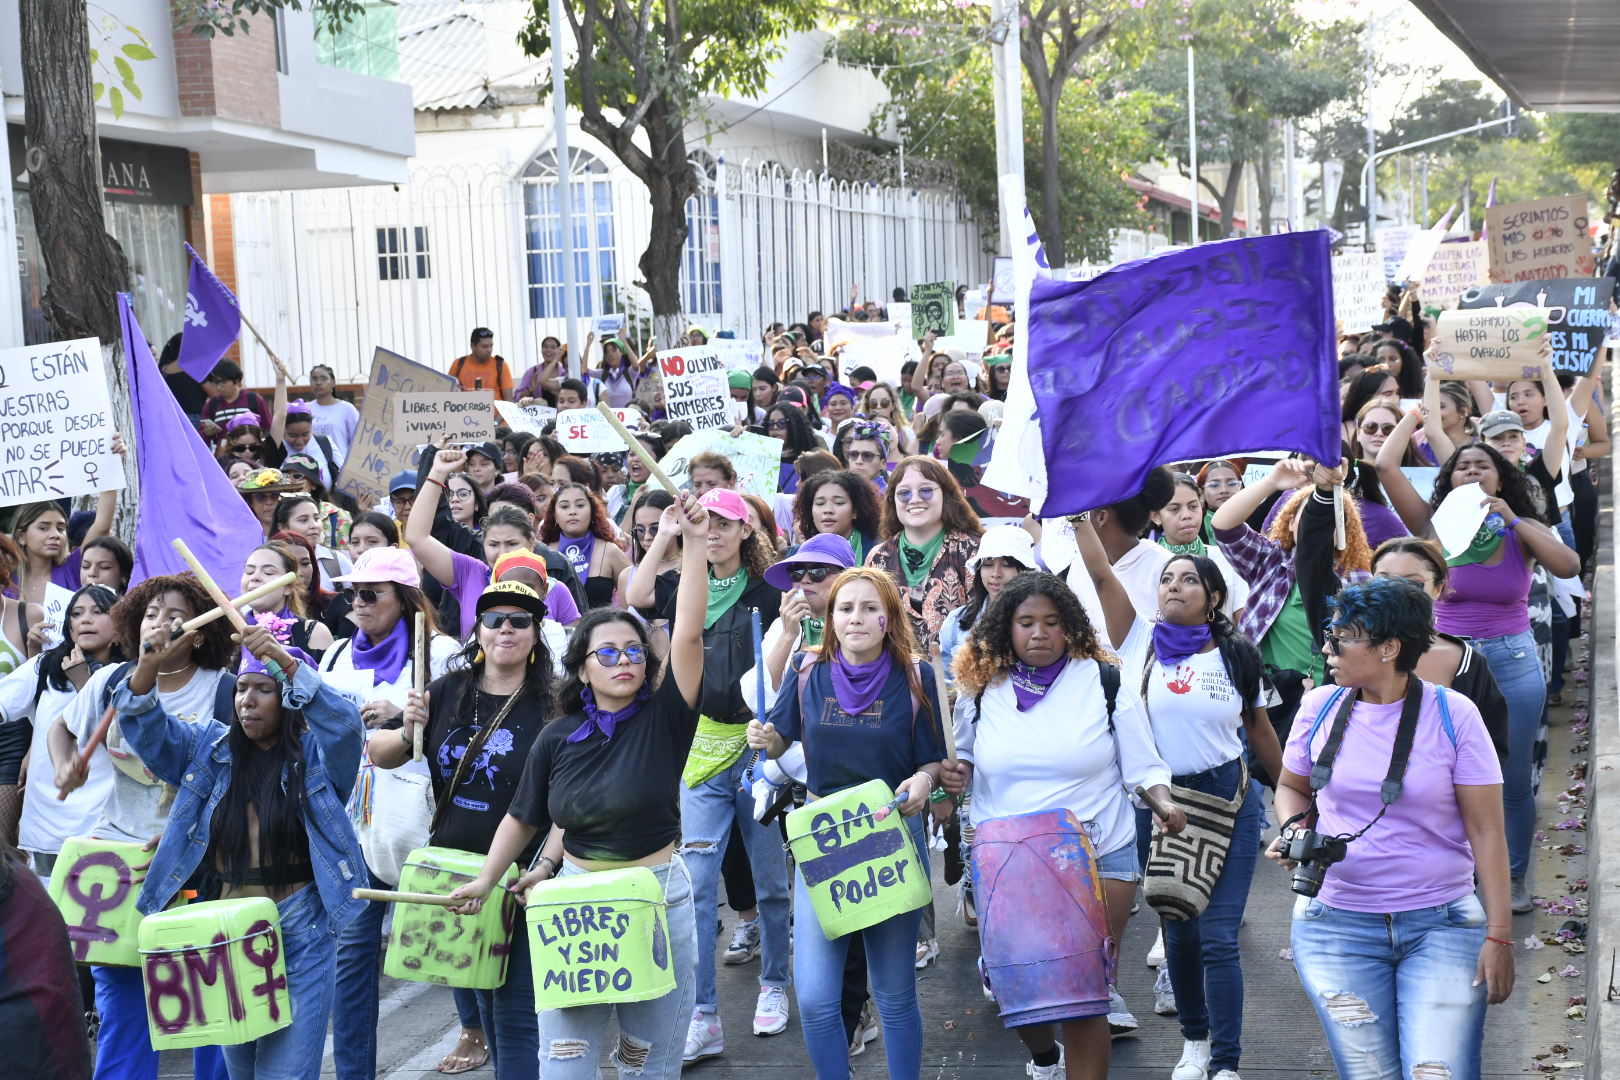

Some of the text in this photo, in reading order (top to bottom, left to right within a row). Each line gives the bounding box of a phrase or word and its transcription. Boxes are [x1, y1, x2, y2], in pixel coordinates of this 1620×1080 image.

[107, 161, 151, 189] ANA
[1574, 286, 1596, 306] MI
[1455, 328, 1520, 343] HASTA LOS
[1551, 331, 1589, 351] ES MI
[30, 344, 89, 381] ESTÁN
[1470, 346, 1512, 359] OVARIOS
[660, 355, 685, 377] NO
[667, 380, 693, 399] SUS
[0, 390, 70, 417] UESTRAS
[667, 395, 725, 420] NOMBRES
[1, 412, 106, 442] PORQUE DESDE
[568, 424, 589, 440] SE
[696, 411, 729, 430] FAVOR
[6, 438, 106, 464] NO SE PUEDE
[494, 583, 512, 593] STAY
[1201, 684, 1227, 693] CONTRA
[1209, 692, 1230, 703] MUJER
[811, 801, 875, 855] 8M
[829, 858, 909, 914] Poder
[537, 904, 630, 947] LIBRES
[557, 940, 620, 966] Y SIN
[145, 930, 246, 1035] 8M
[543, 966, 633, 994] MIEDO
